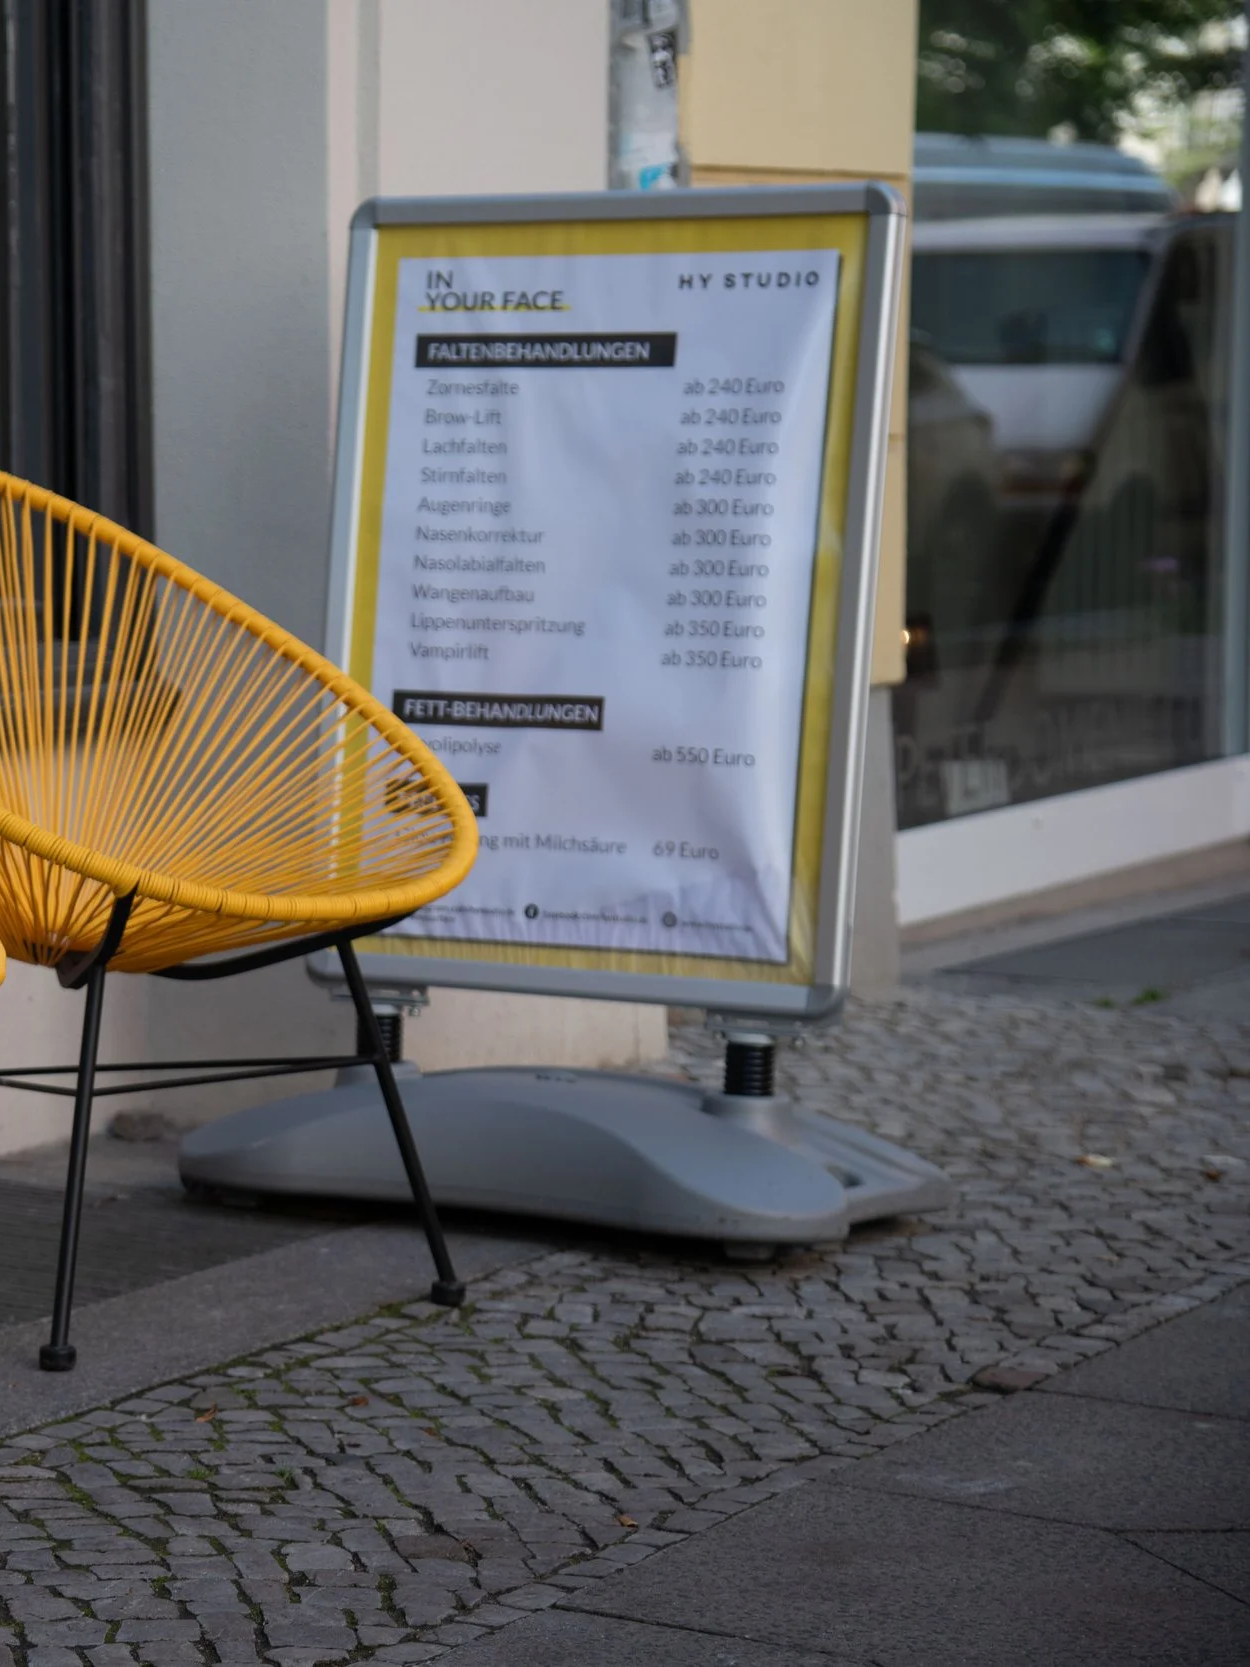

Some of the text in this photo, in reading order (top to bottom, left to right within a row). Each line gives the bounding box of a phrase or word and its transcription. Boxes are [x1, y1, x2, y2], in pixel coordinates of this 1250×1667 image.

[427, 270, 453, 289] IN
[678, 271, 820, 290] HY STUDIO
[426, 290, 564, 311] YOUR FACE
[427, 342, 651, 360] FALTENBEHANDLUNGEN
[426, 379, 519, 396] Zornesfalte
[683, 378, 786, 395] ab 240 Euro
[424, 408, 502, 426] Brow-Lift
[680, 408, 782, 425] ab 240 Euro
[422, 438, 508, 455] Lachfalten
[677, 438, 780, 455] ab 240 Euro
[420, 466, 508, 485] Stirnfalten
[674, 468, 777, 486] ab 240 Euro
[416, 496, 512, 516] Augenringe
[672, 499, 774, 516] ab 300 Euro
[415, 525, 545, 544] Nasenkorrektur
[671, 529, 772, 547] ab 300 Euro
[413, 554, 546, 574] Nasolabialfalten
[668, 559, 769, 577] ab 300 Euro
[411, 584, 535, 603] Wangenaufbau
[666, 590, 767, 607] ab 300 Euro
[410, 613, 586, 636] Lippenunterspritzung
[664, 620, 765, 638] ab 350 Euro
[409, 642, 490, 661] Vampirlift
[661, 651, 762, 668] ab 350 Euro
[403, 698, 599, 722] FETT-BEHANDLUNGEN
[652, 745, 755, 766] ab 550 Euro
[503, 831, 532, 849] mit
[535, 833, 627, 855] Milchsäure
[652, 841, 720, 860] 69 Euro
